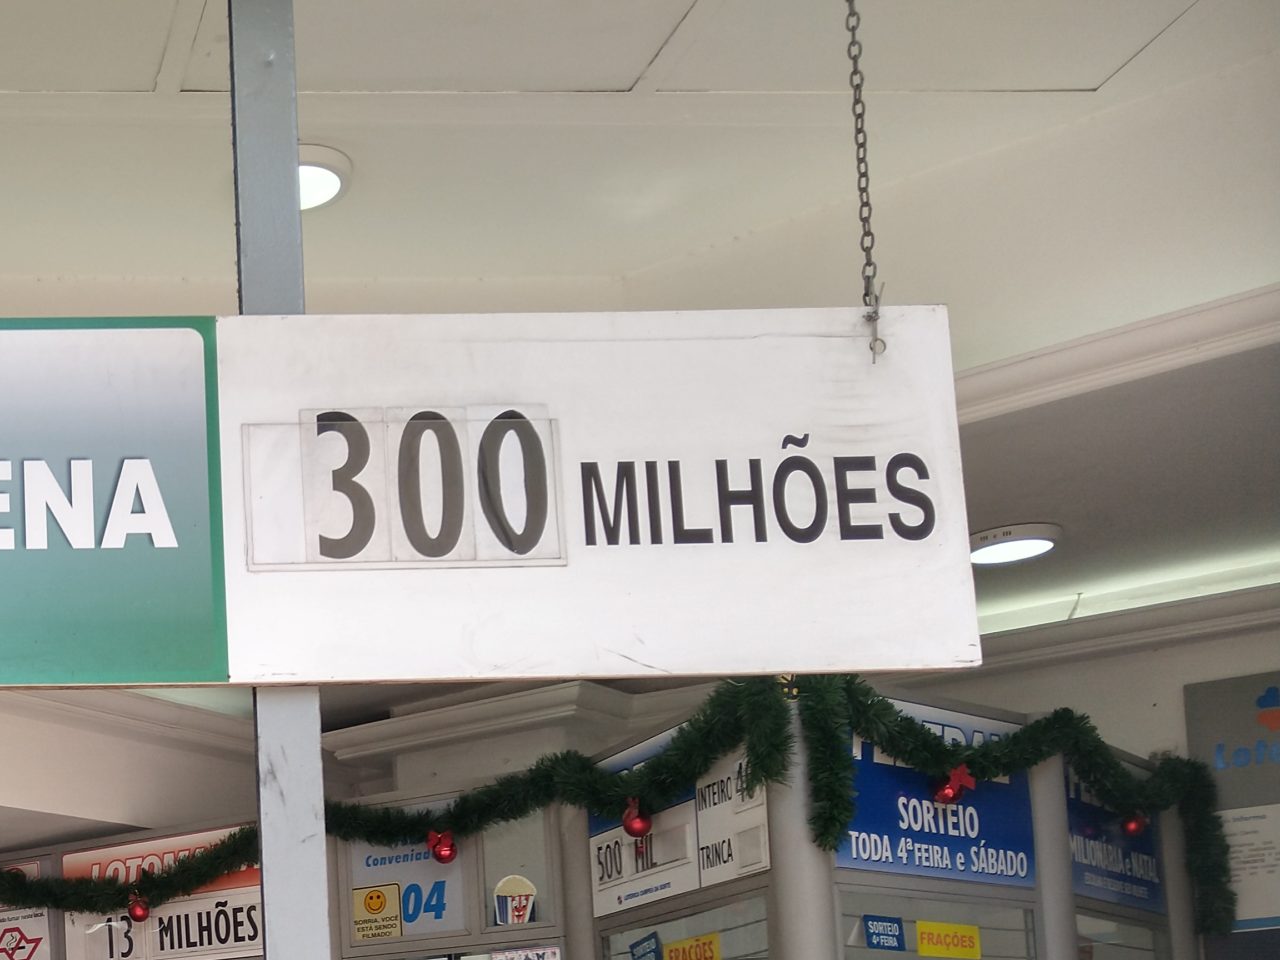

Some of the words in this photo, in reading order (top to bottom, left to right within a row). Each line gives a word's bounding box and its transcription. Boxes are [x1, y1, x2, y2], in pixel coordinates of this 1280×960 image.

[316, 410, 548, 559] 300
[581, 433, 936, 546] MILHÕES
[698, 777, 733, 811] INTEIRO
[898, 796, 979, 839] SORTEIO
[597, 840, 623, 881] 500
[700, 838, 734, 870] TRINCA
[848, 831, 893, 863] TODA
[914, 843, 952, 869] FEIRA
[956, 852, 965, 871] e
[971, 840, 1028, 878] SÁBADO
[381, 914, 399, 923] VOCÊ
[402, 880, 447, 924] 04
[106, 915, 134, 959] 13
[158, 901, 259, 951] MILHÕES
[362, 931, 392, 939] FILMADO!
[375, 923, 397, 931] SENDO
[868, 921, 899, 935] SORTEIO
[920, 931, 976, 950] FRAÇÕES
